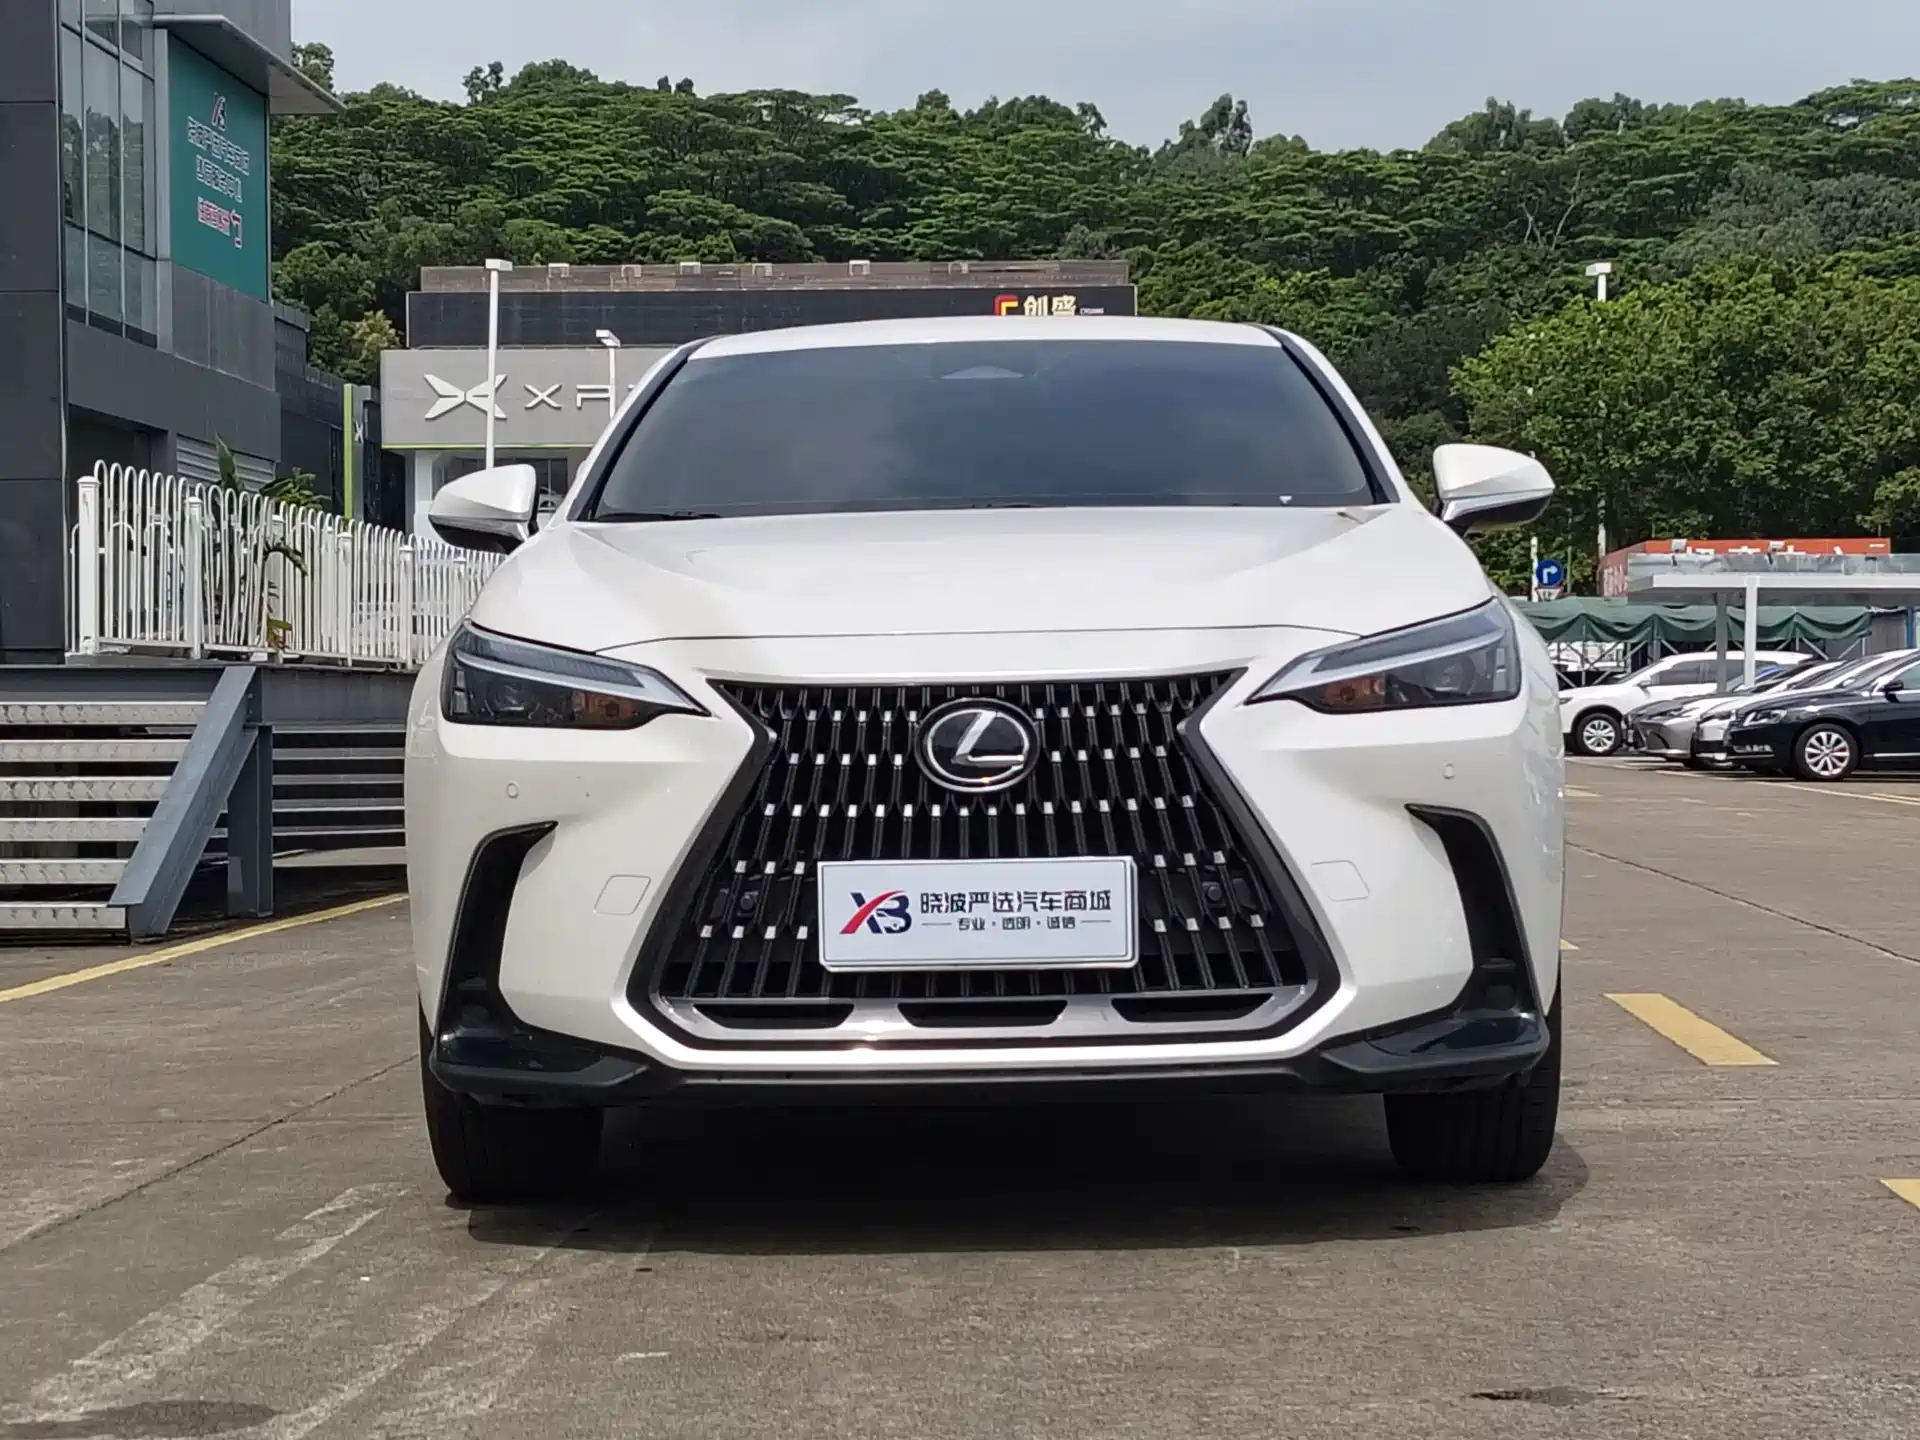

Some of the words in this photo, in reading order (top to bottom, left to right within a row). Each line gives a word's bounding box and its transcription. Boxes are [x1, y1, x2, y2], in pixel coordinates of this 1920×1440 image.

[524, 384, 635, 411] XP
[840, 890, 912, 934] XB
[920, 890, 1111, 914] 晓波严选汽车商城
